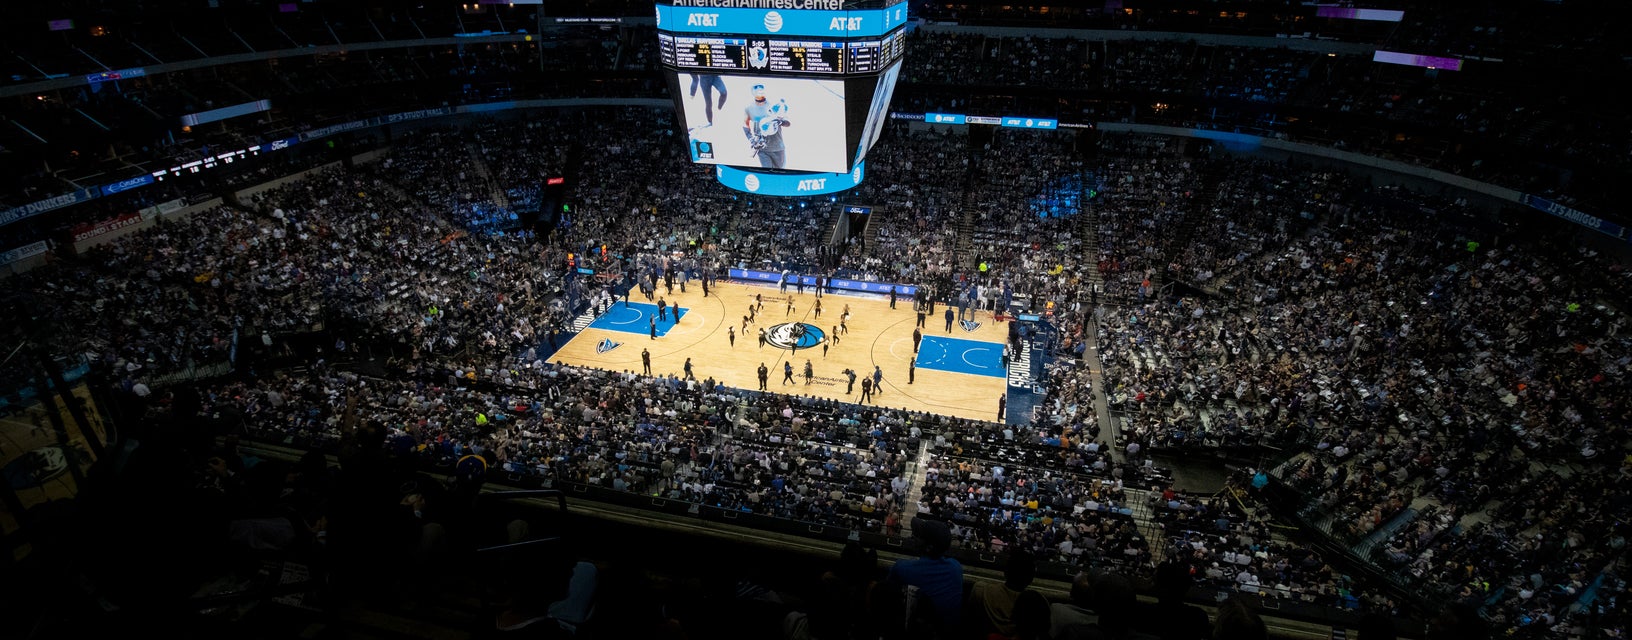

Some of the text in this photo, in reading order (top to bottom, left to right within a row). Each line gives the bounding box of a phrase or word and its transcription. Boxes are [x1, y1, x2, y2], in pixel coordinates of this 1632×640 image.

[688, 13, 719, 26] AT&T
[829, 17, 863, 31] AT&T
[271, 139, 289, 151] Ford
[797, 178, 827, 192] AT&T
[0, 193, 76, 225] IRK'S DUNKERS
[1565, 207, 1603, 228] AMIGOS
[74, 227, 107, 241] SOUND
